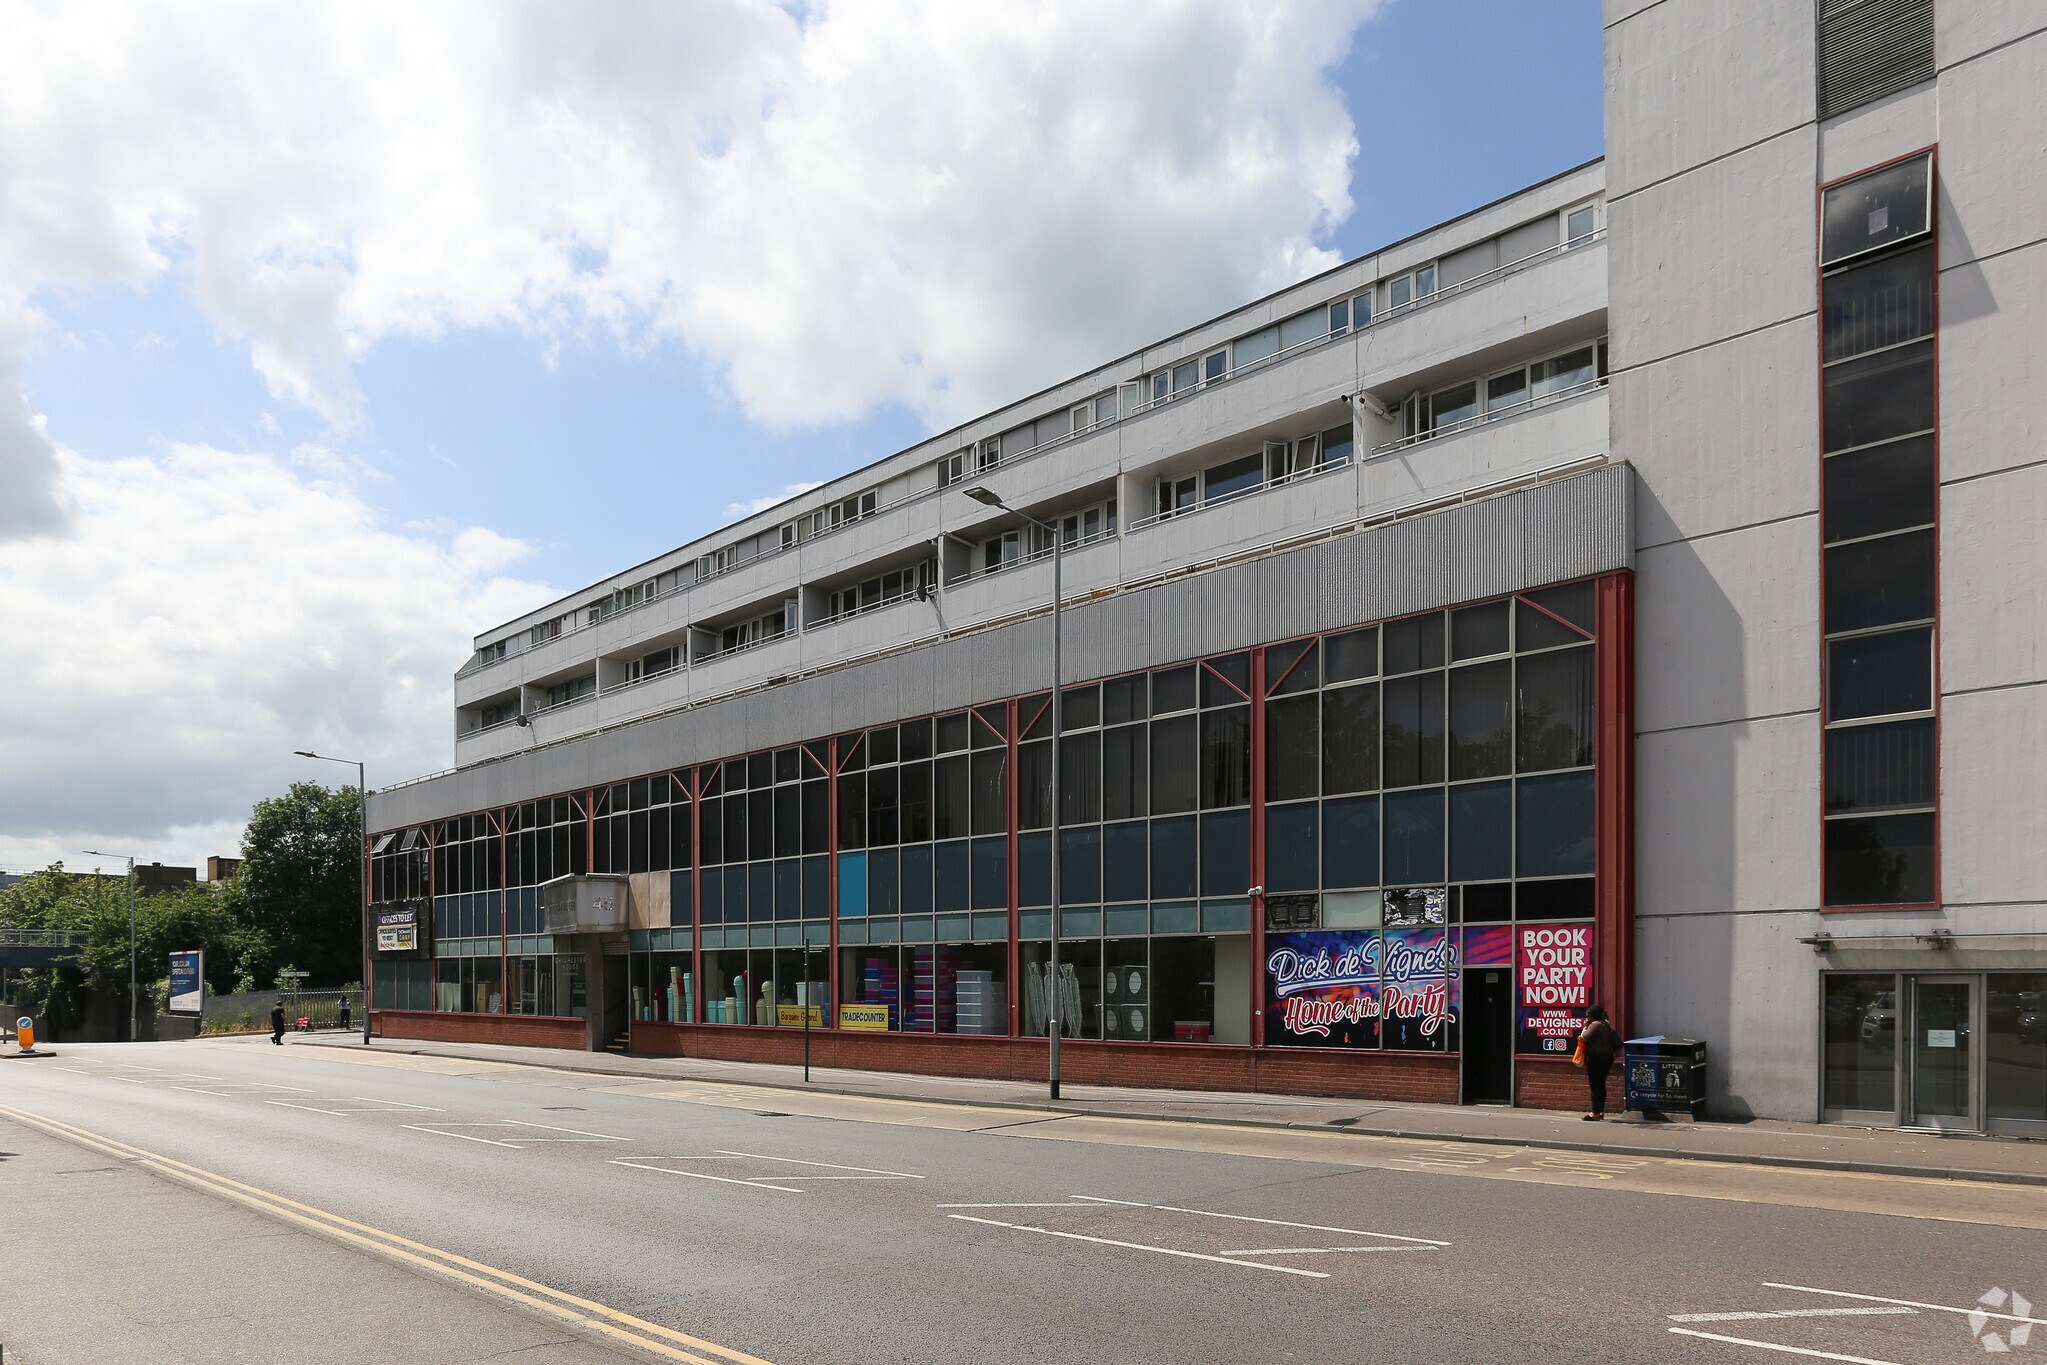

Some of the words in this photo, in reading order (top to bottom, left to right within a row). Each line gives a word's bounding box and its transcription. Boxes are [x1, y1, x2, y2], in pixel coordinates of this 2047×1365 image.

[1523, 928, 1587, 948] BOOK
[1268, 946, 1332, 984] Dick
[1335, 947, 1361, 977] de
[1361, 936, 1458, 983] Vigne's
[1526, 948, 1585, 966] YOUR
[1523, 967, 1587, 985] PARTY
[1526, 986, 1585, 1004] NOW!
[780, 1010, 800, 1023] Bargains
[1284, 996, 1345, 1036] Home
[1344, 997, 1361, 1024] of
[1360, 997, 1380, 1017] the
[1382, 983, 1456, 1036] Party
[1542, 1010, 1568, 1018] WWW.
[1528, 1018, 1582, 1028] DEVIGNES
[1540, 1028, 1570, 1036] .CO.UK
